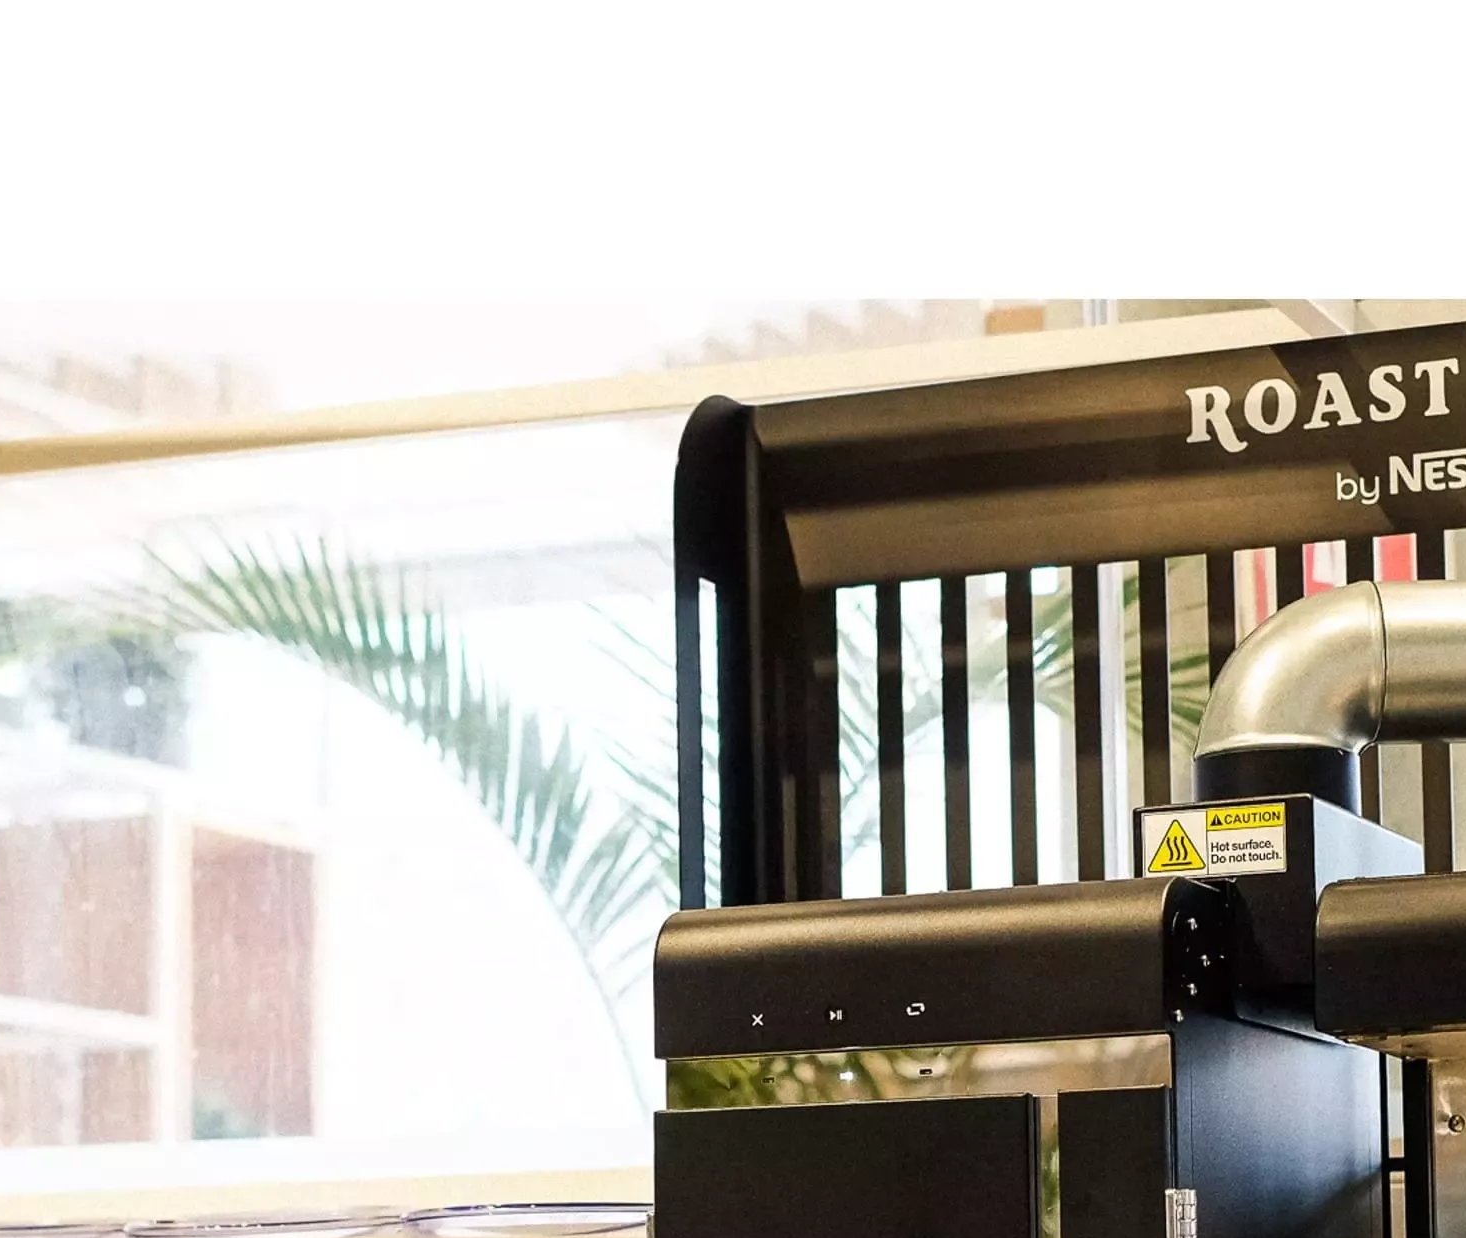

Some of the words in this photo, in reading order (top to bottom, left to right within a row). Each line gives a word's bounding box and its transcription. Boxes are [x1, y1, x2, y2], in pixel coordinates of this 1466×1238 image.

[1336, 472, 1381, 505] by
[1224, 811, 1281, 825] CAUTION
[1210, 841, 1230, 853] Hot
[1232, 838, 1274, 851] surface.
[1210, 854, 1227, 865] Do
[1229, 853, 1246, 863] not
[1248, 851, 1282, 862] touch.
